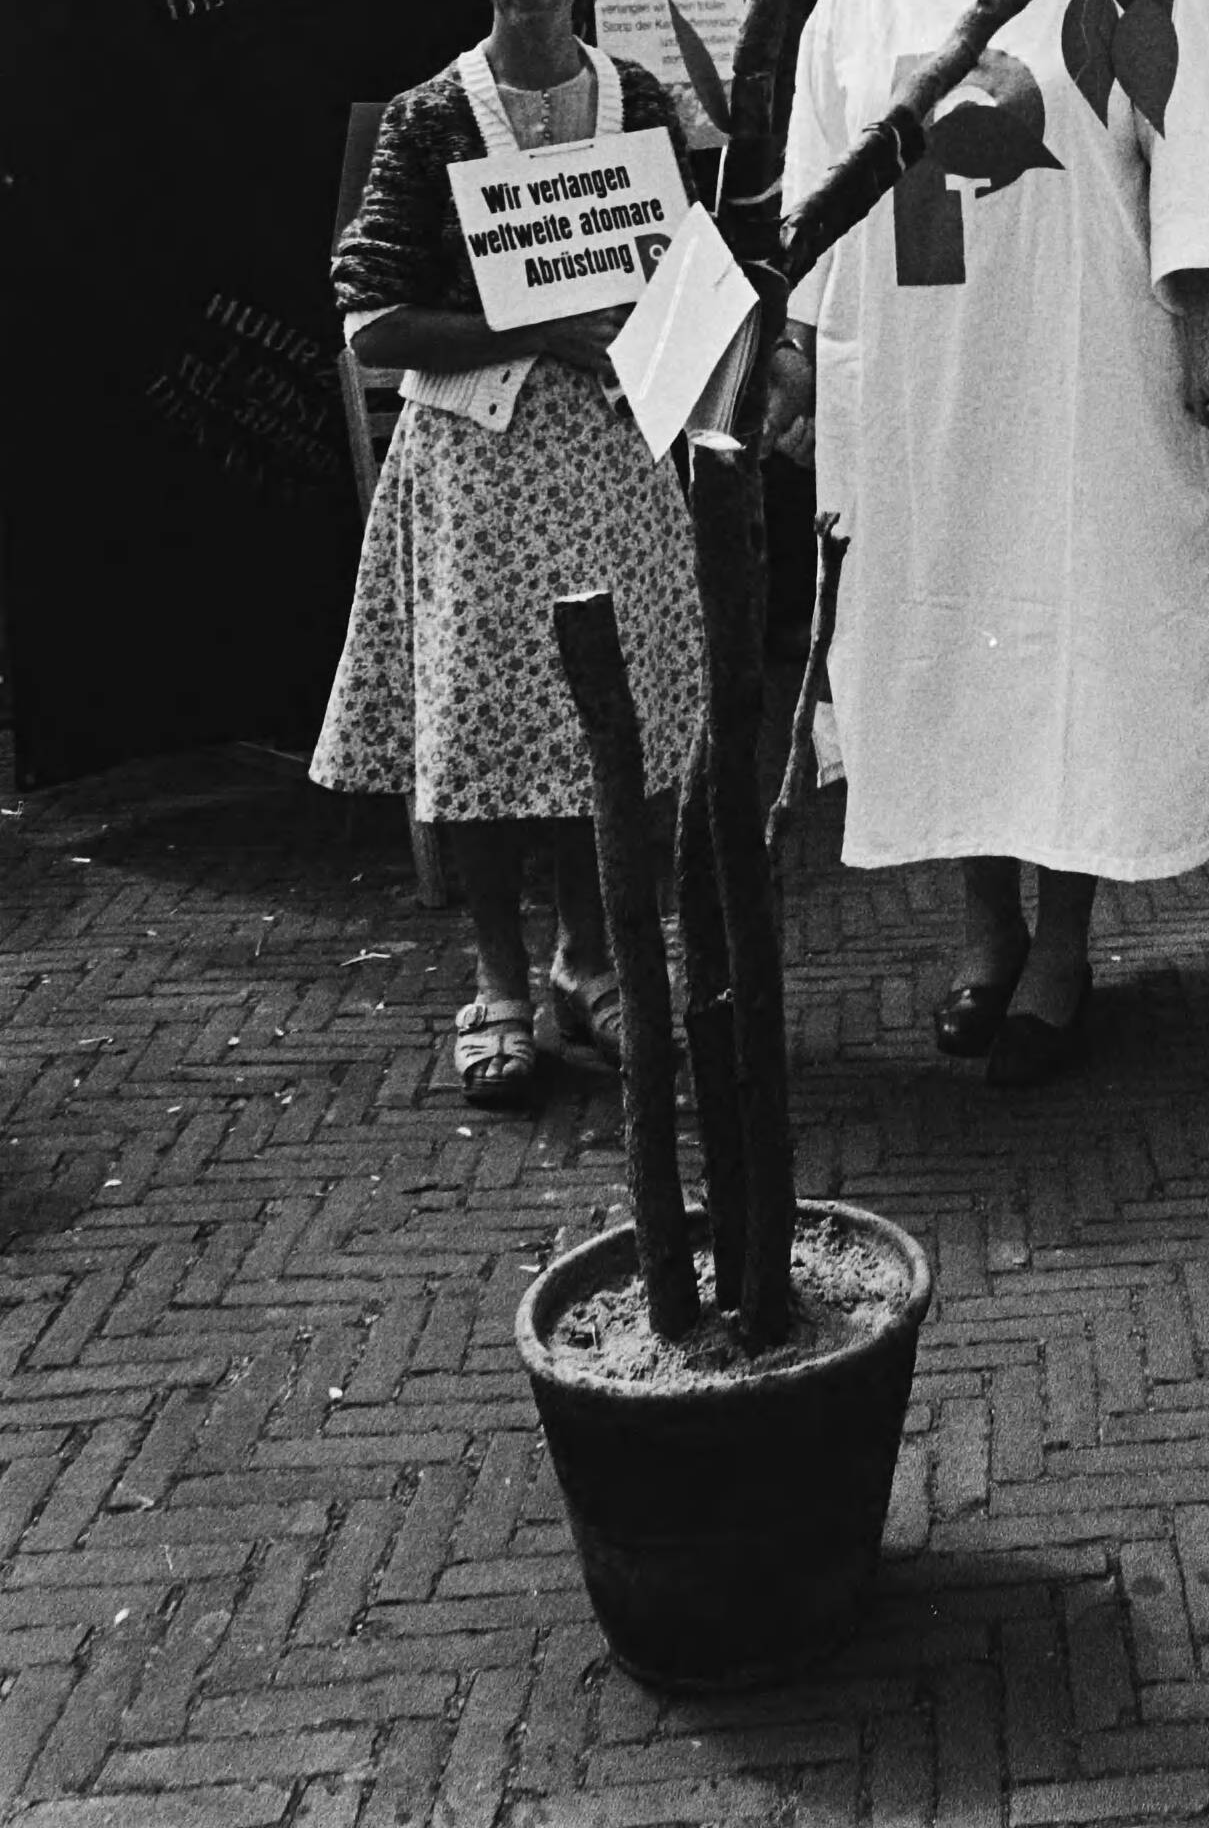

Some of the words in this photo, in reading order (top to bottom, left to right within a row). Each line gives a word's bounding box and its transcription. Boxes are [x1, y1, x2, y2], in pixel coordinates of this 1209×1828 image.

[480, 182, 522, 214] Wir
[527, 165, 631, 206] verlangen
[468, 213, 573, 258] weltweite
[579, 198, 665, 236] atomare
[524, 243, 635, 288] Abrüstung
